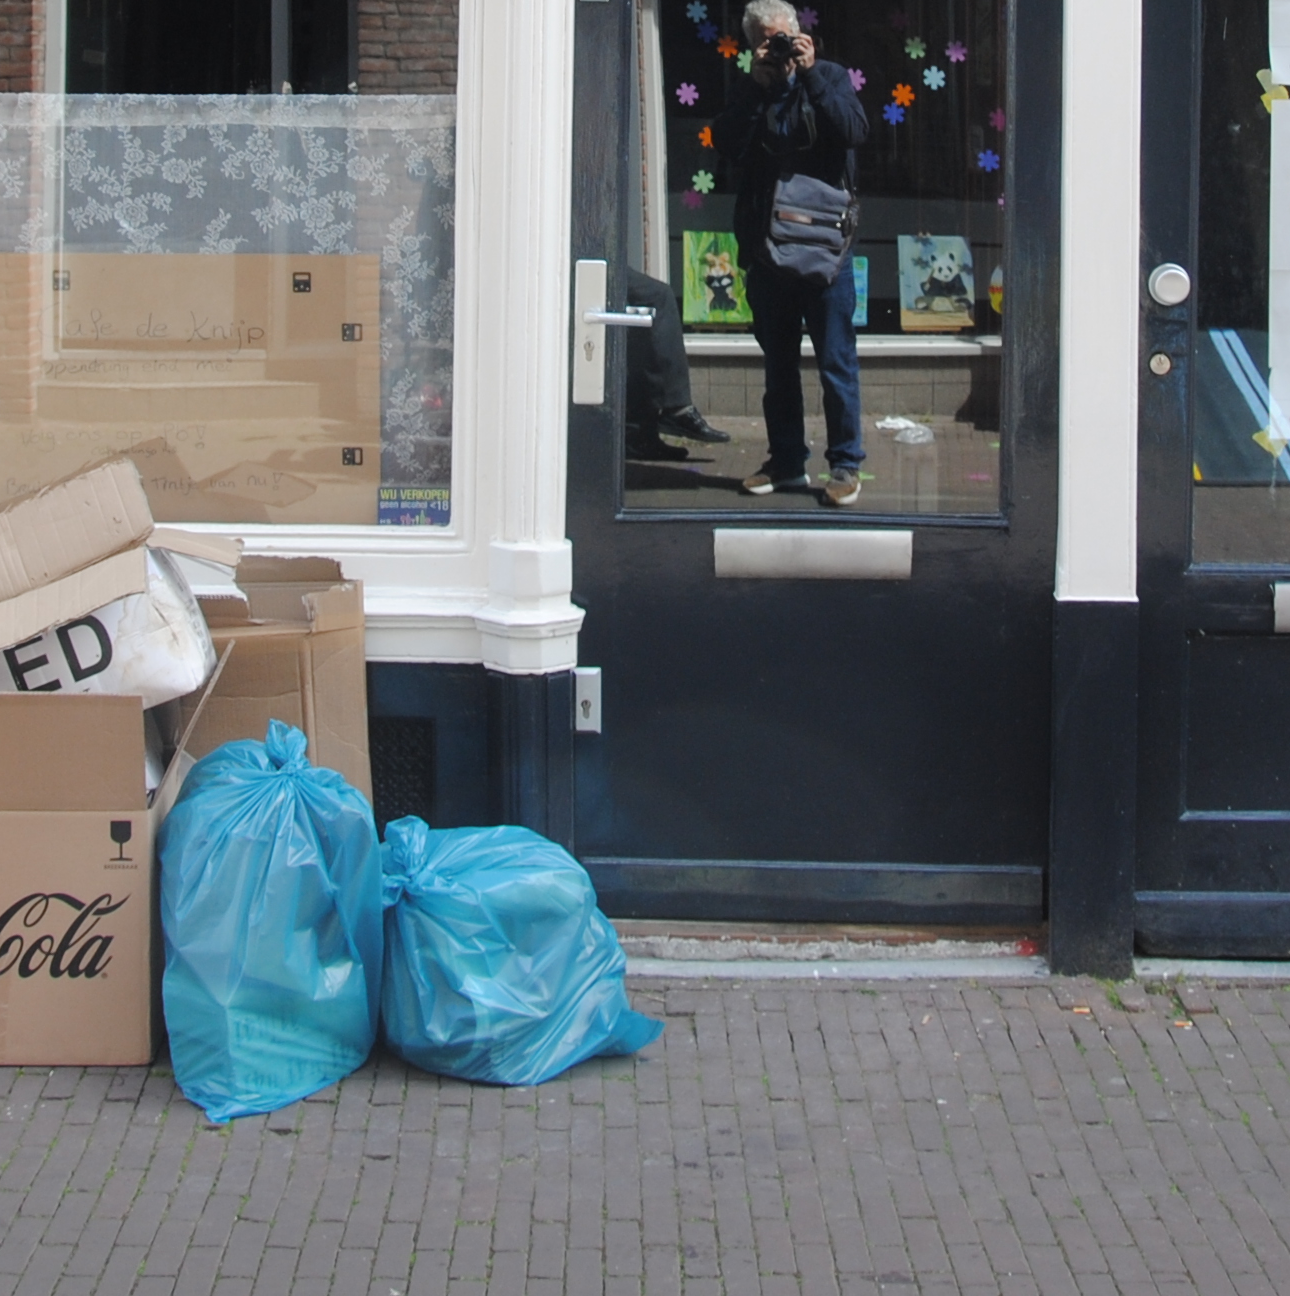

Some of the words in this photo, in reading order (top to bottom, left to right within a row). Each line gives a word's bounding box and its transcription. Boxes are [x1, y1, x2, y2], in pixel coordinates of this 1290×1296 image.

[137, 312, 168, 338] de
[187, 310, 265, 355] Knijp
[65, 430, 101, 442] ons
[115, 430, 143, 446] op
[209, 478, 236, 489] van
[379, 488, 397, 501] WIJ
[400, 488, 449, 501] VERKOPEN
